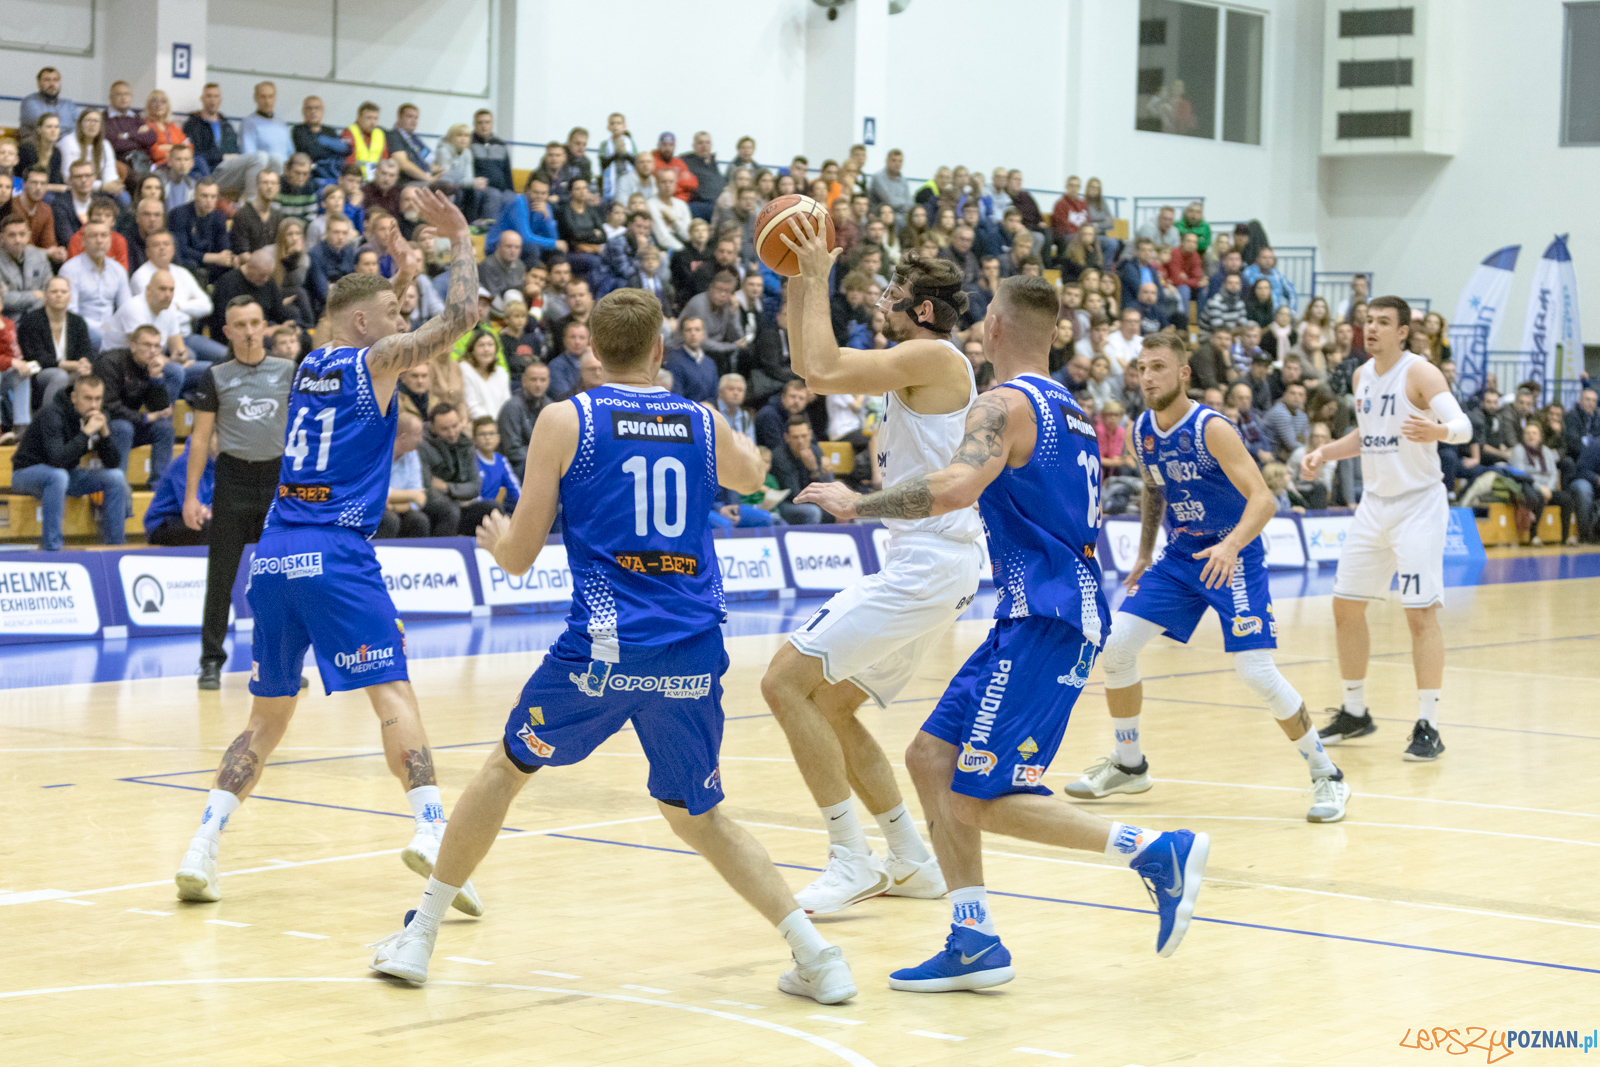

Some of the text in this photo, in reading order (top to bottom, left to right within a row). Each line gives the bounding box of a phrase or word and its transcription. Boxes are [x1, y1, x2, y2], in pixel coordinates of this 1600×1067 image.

[175, 47, 189, 74] B
[595, 397, 698, 414] POGOŃ PRUDNIK
[1380, 393, 1397, 417] 71
[285, 406, 337, 472] 41
[1180, 460, 1202, 482] 32
[621, 454, 687, 538] 10
[616, 555, 698, 575] WA-BET
[795, 556, 853, 573] BIOFARM
[1401, 573, 1421, 595] 71
[1, 595, 75, 612] EXHIBITIONS
[334, 644, 394, 670] Optima
[351, 659, 395, 675] MEDYCYNA
[608, 673, 712, 692] OPOLSKIE
[969, 659, 1013, 745] PRUDNIK
[963, 753, 989, 767] LOTTO
